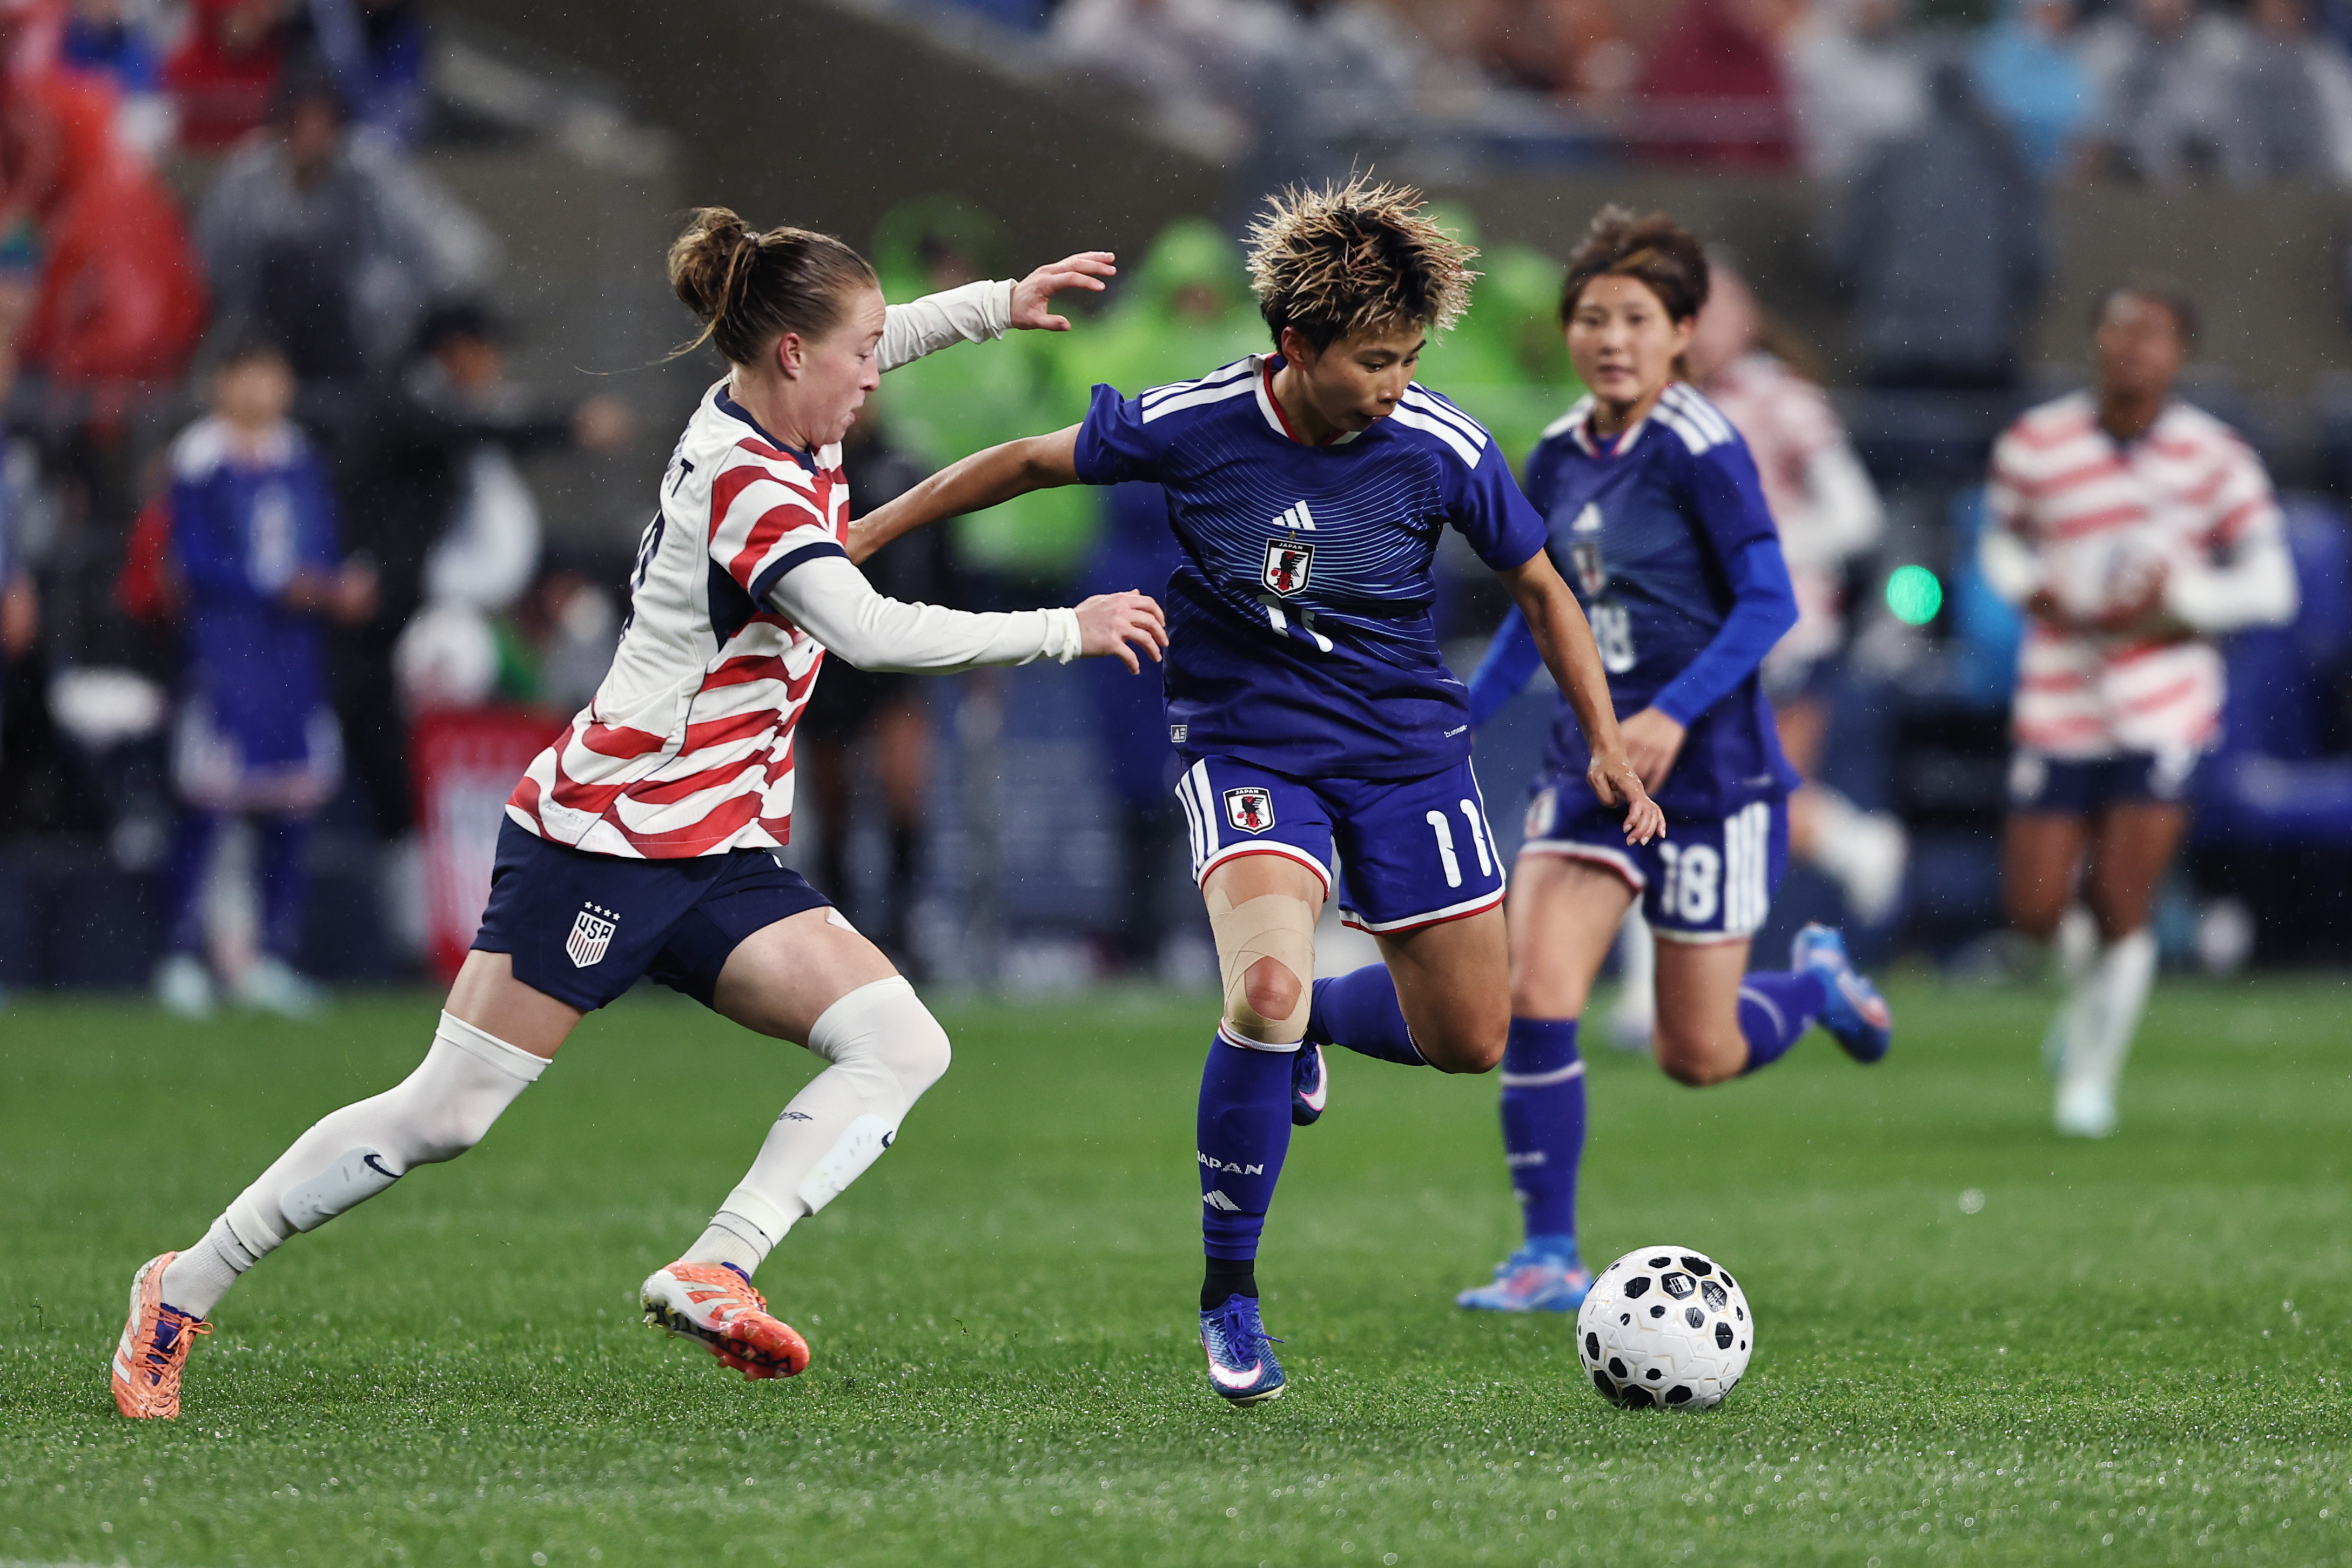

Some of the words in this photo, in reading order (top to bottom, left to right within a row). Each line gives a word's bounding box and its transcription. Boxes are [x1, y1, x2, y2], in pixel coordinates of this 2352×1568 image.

[1274, 578, 1294, 588] JFA
[1426, 799, 1491, 887] 11
[1658, 840, 1721, 923] 18
[578, 914, 611, 939] USA
